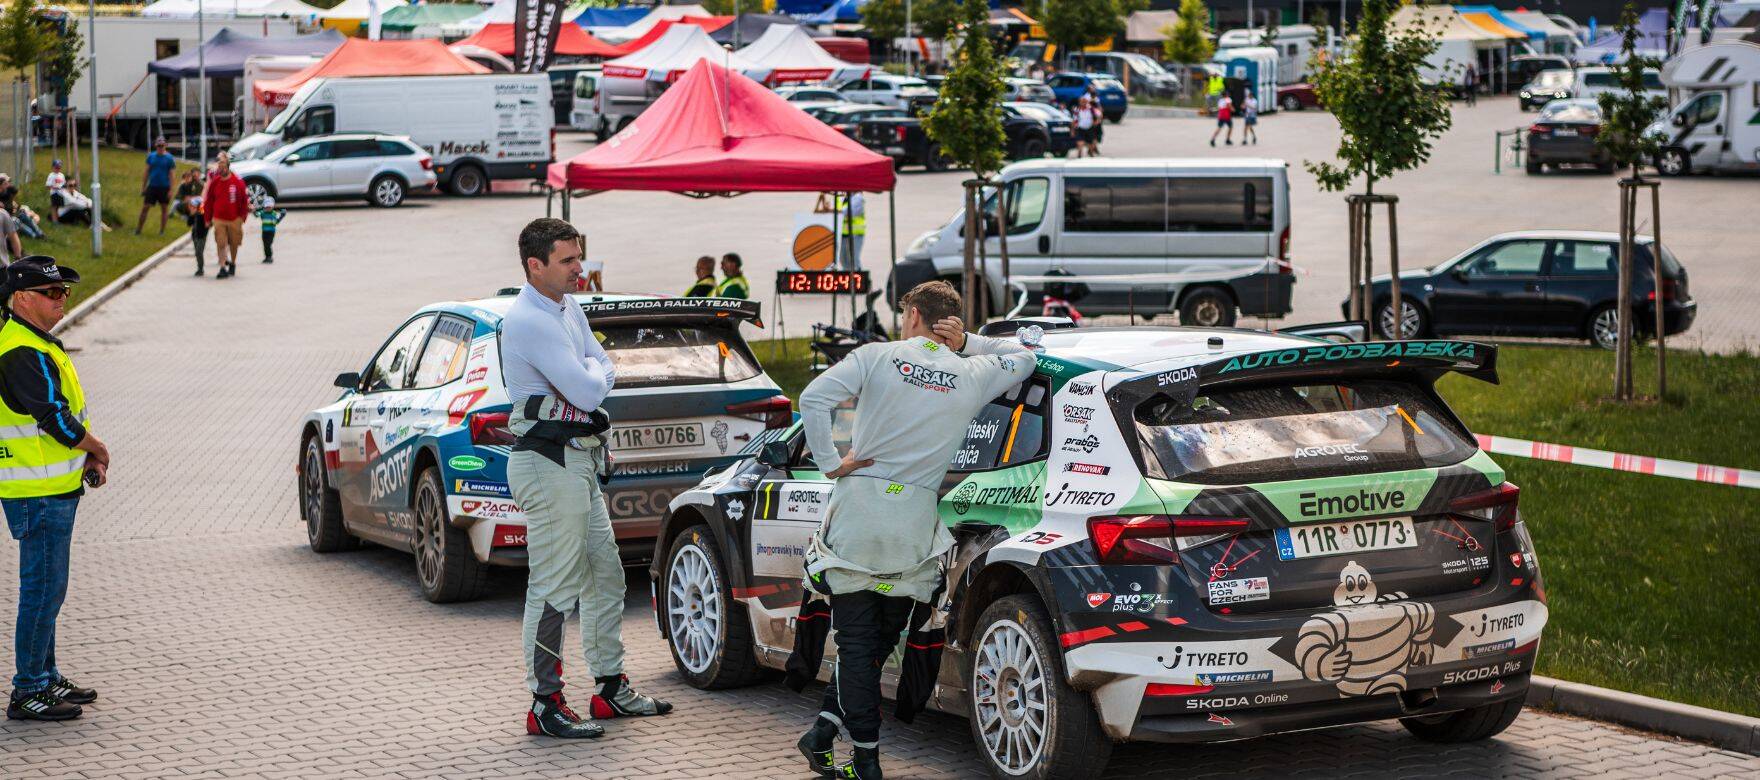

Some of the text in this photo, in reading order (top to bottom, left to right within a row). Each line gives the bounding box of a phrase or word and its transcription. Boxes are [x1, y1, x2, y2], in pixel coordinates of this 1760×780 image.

[440, 140, 490, 156] Macek
[582, 302, 616, 312] OTEC
[664, 300, 703, 308] RALLY
[706, 300, 742, 309] TEAM
[1218, 349, 1299, 374] AUTO
[899, 360, 958, 390] ORSAK
[613, 426, 696, 448] 11R 0766
[1064, 437, 1101, 449] prabos
[952, 445, 980, 468] rajča
[1295, 443, 1368, 459] AGROTEC
[1344, 455, 1369, 463] Group
[614, 461, 689, 476] AGROFERT
[471, 484, 508, 492] MICHELIN
[788, 490, 821, 504] AGROTEC
[975, 485, 1040, 506] OPTIMAL
[1063, 490, 1116, 506] TYRETO
[1300, 489, 1406, 517] Emotive
[504, 535, 528, 544] SK
[1298, 520, 1407, 554] 11R 0773
[1281, 548, 1293, 557] CZ
[1470, 556, 1489, 567] 125
[1210, 581, 1238, 590] FANS
[1114, 594, 1140, 604] EVO
[1211, 589, 1233, 597] FOR
[1211, 595, 1247, 604] CZECH
[1112, 603, 1134, 613] plus
[1489, 612, 1524, 633] TYRETO
[1477, 640, 1514, 654] MICHELIN
[1186, 652, 1249, 667] TYRETO
[1503, 660, 1521, 674] Plus
[1215, 672, 1269, 683] MICHELIN
[1254, 693, 1289, 705] Online
